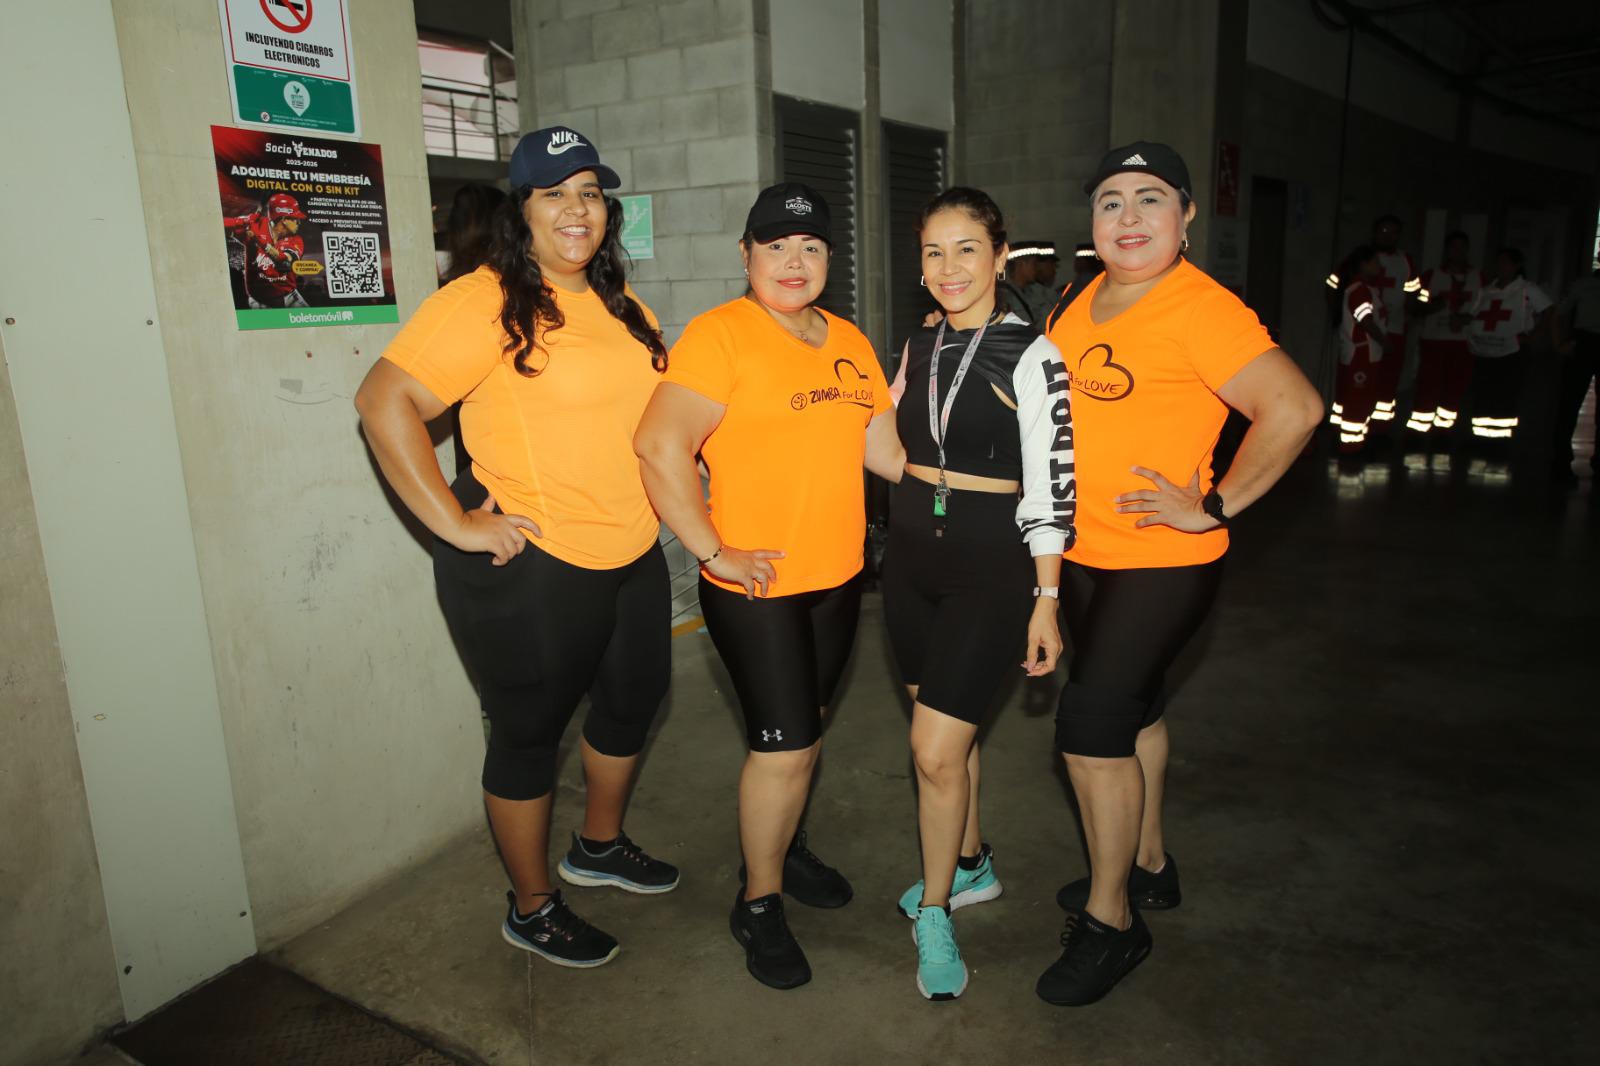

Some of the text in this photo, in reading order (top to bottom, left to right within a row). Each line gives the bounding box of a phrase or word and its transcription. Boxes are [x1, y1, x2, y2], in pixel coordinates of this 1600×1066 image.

[245, 31, 334, 58] INCLUYENDO CIGARROS
[264, 49, 321, 69] ELECTRONICOS
[551, 130, 579, 145] NIKE
[265, 140, 338, 159] Socio VENADOS
[286, 158, 318, 167] 2025-2026
[231, 165, 372, 186] ADQUIERE TU MEMBRESÍA
[246, 179, 360, 196] DIGITAL CON O SIN KIT
[785, 202, 812, 213] LACOSTE
[289, 311, 342, 324] boletomóvil
[1041, 359, 1071, 395] IT
[809, 386, 841, 404] ZUMBA
[1084, 379, 1123, 395] LOVE
[1050, 397, 1075, 452] DO
